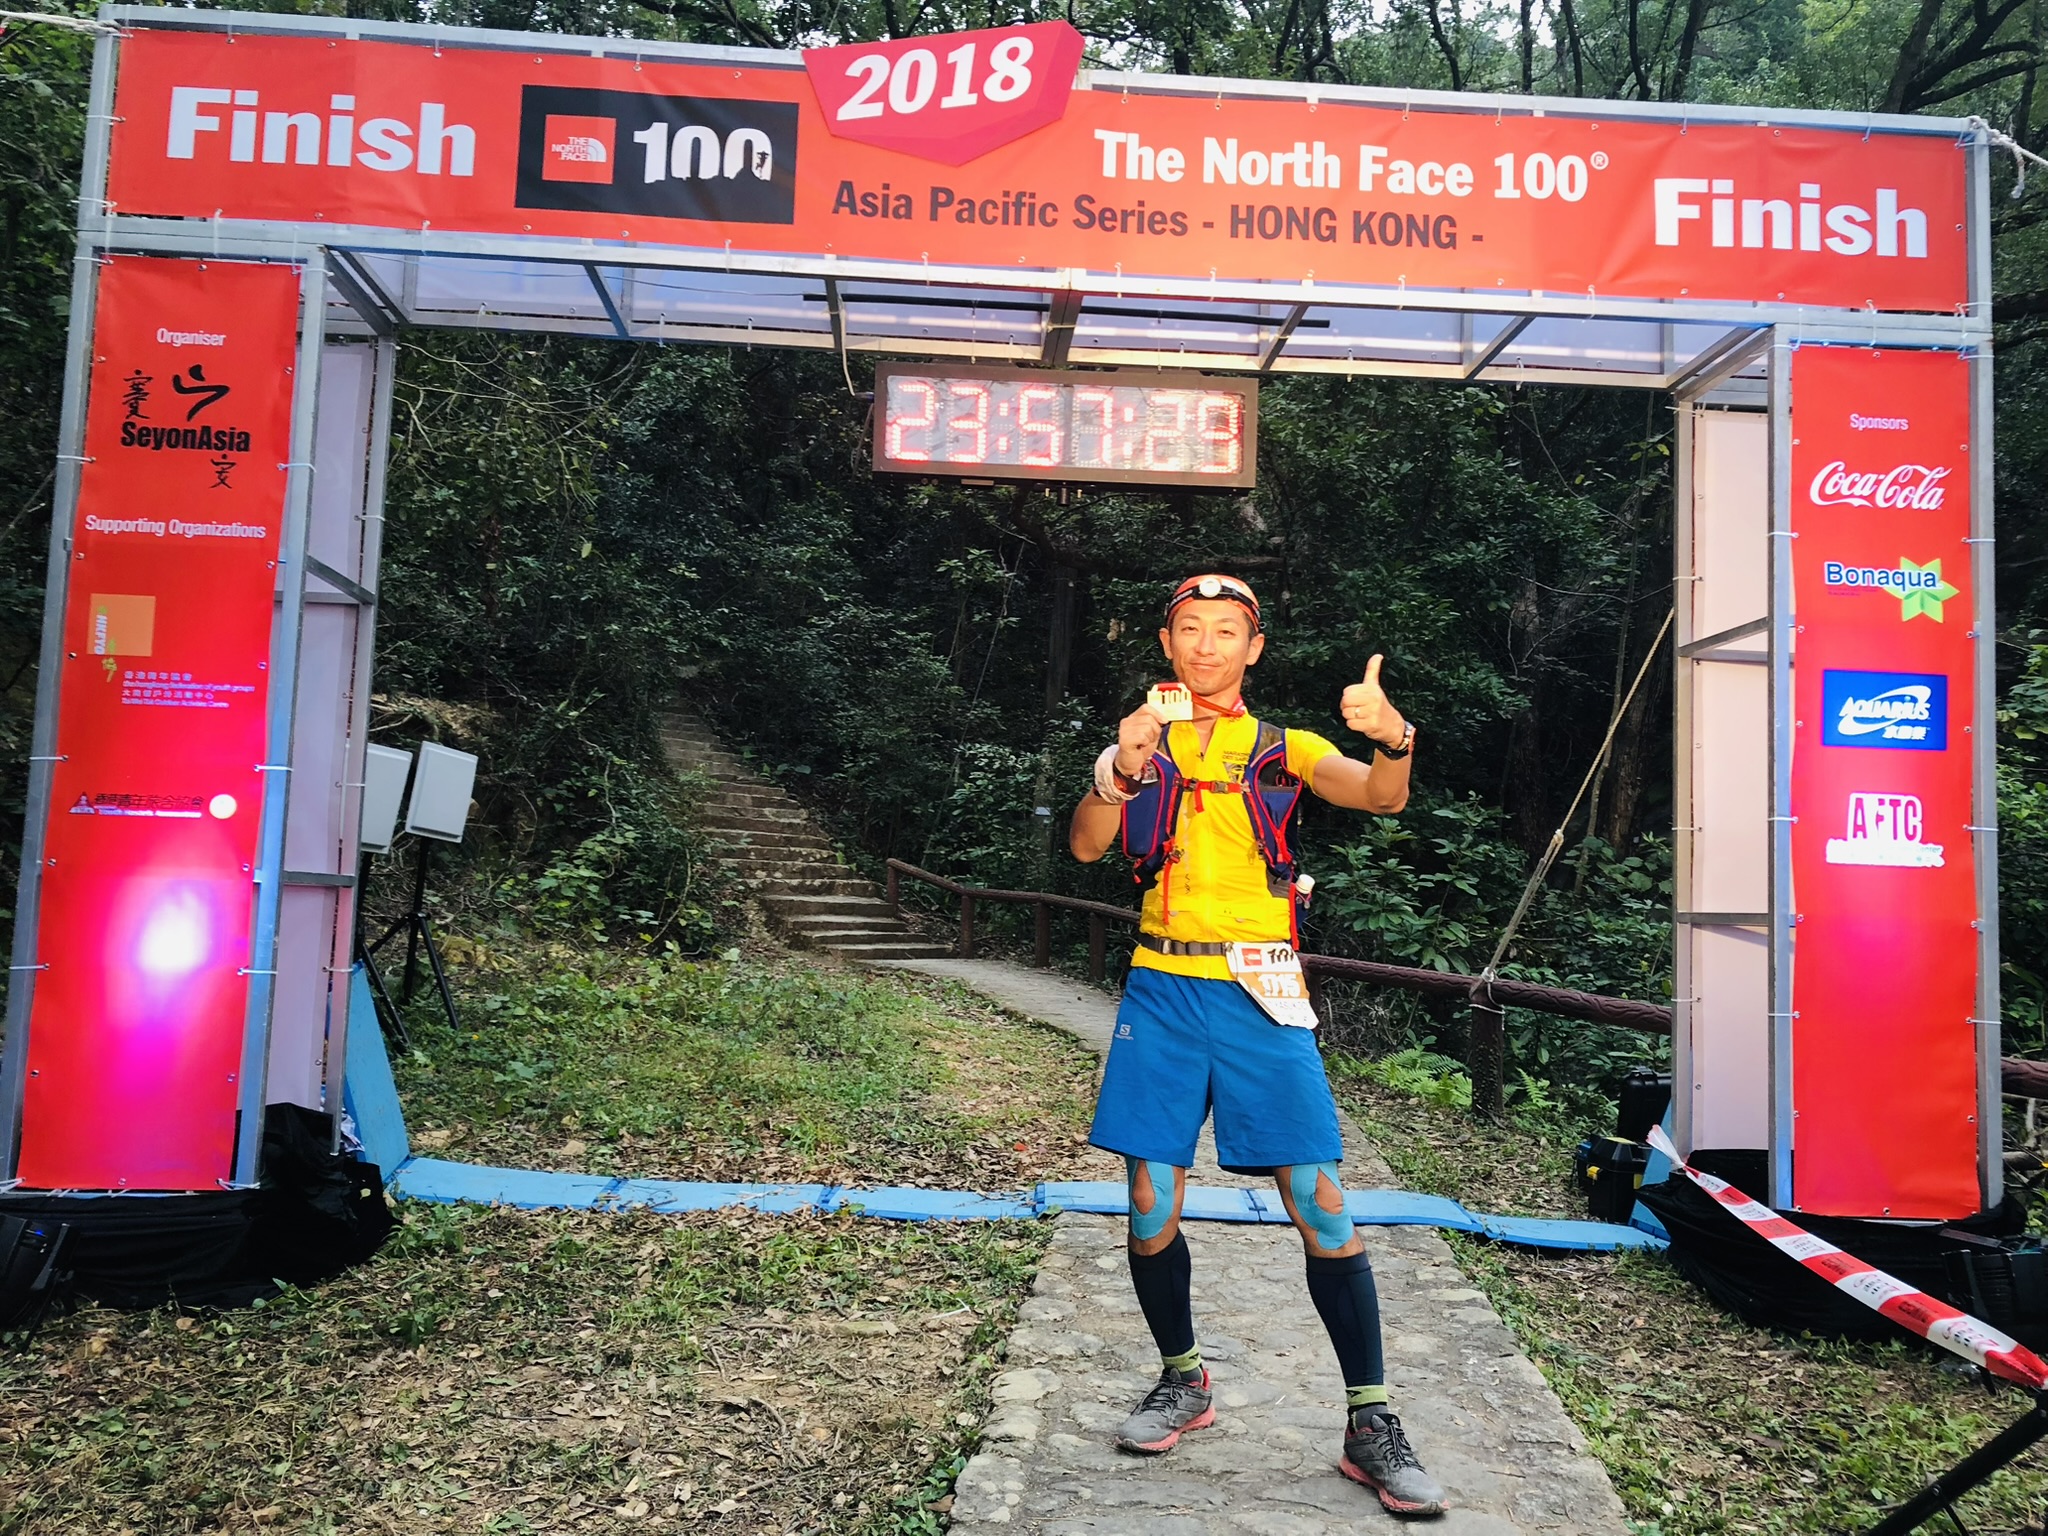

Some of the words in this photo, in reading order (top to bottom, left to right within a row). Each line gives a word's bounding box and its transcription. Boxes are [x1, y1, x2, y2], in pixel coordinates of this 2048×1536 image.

[835, 36, 1034, 121] 2018
[166, 86, 476, 177] Finish
[551, 144, 587, 153] NORTH
[568, 136, 588, 145] THE
[560, 152, 589, 162] FACE
[633, 121, 773, 184] 100
[1094, 129, 1185, 182] The
[1203, 137, 1340, 189] North
[1359, 145, 1474, 197] Face
[831, 180, 913, 220] Asia
[929, 186, 1058, 228] Pacific
[1073, 194, 1188, 236] Series
[1230, 204, 1337, 243] HONG
[1353, 210, 1457, 249] KONG
[1653, 177, 1928, 258] Finish
[156, 328, 227, 347] Organiser
[120, 421, 251, 452] SeyonAsia
[1850, 413, 1909, 431] Sponsors
[1809, 461, 1952, 510] Coca-Cola
[85, 514, 166, 537] Supporting
[168, 518, 267, 539] Organizations
[1826, 562, 1937, 592] Bonaqua
[1852, 797, 1919, 841] AFTC
